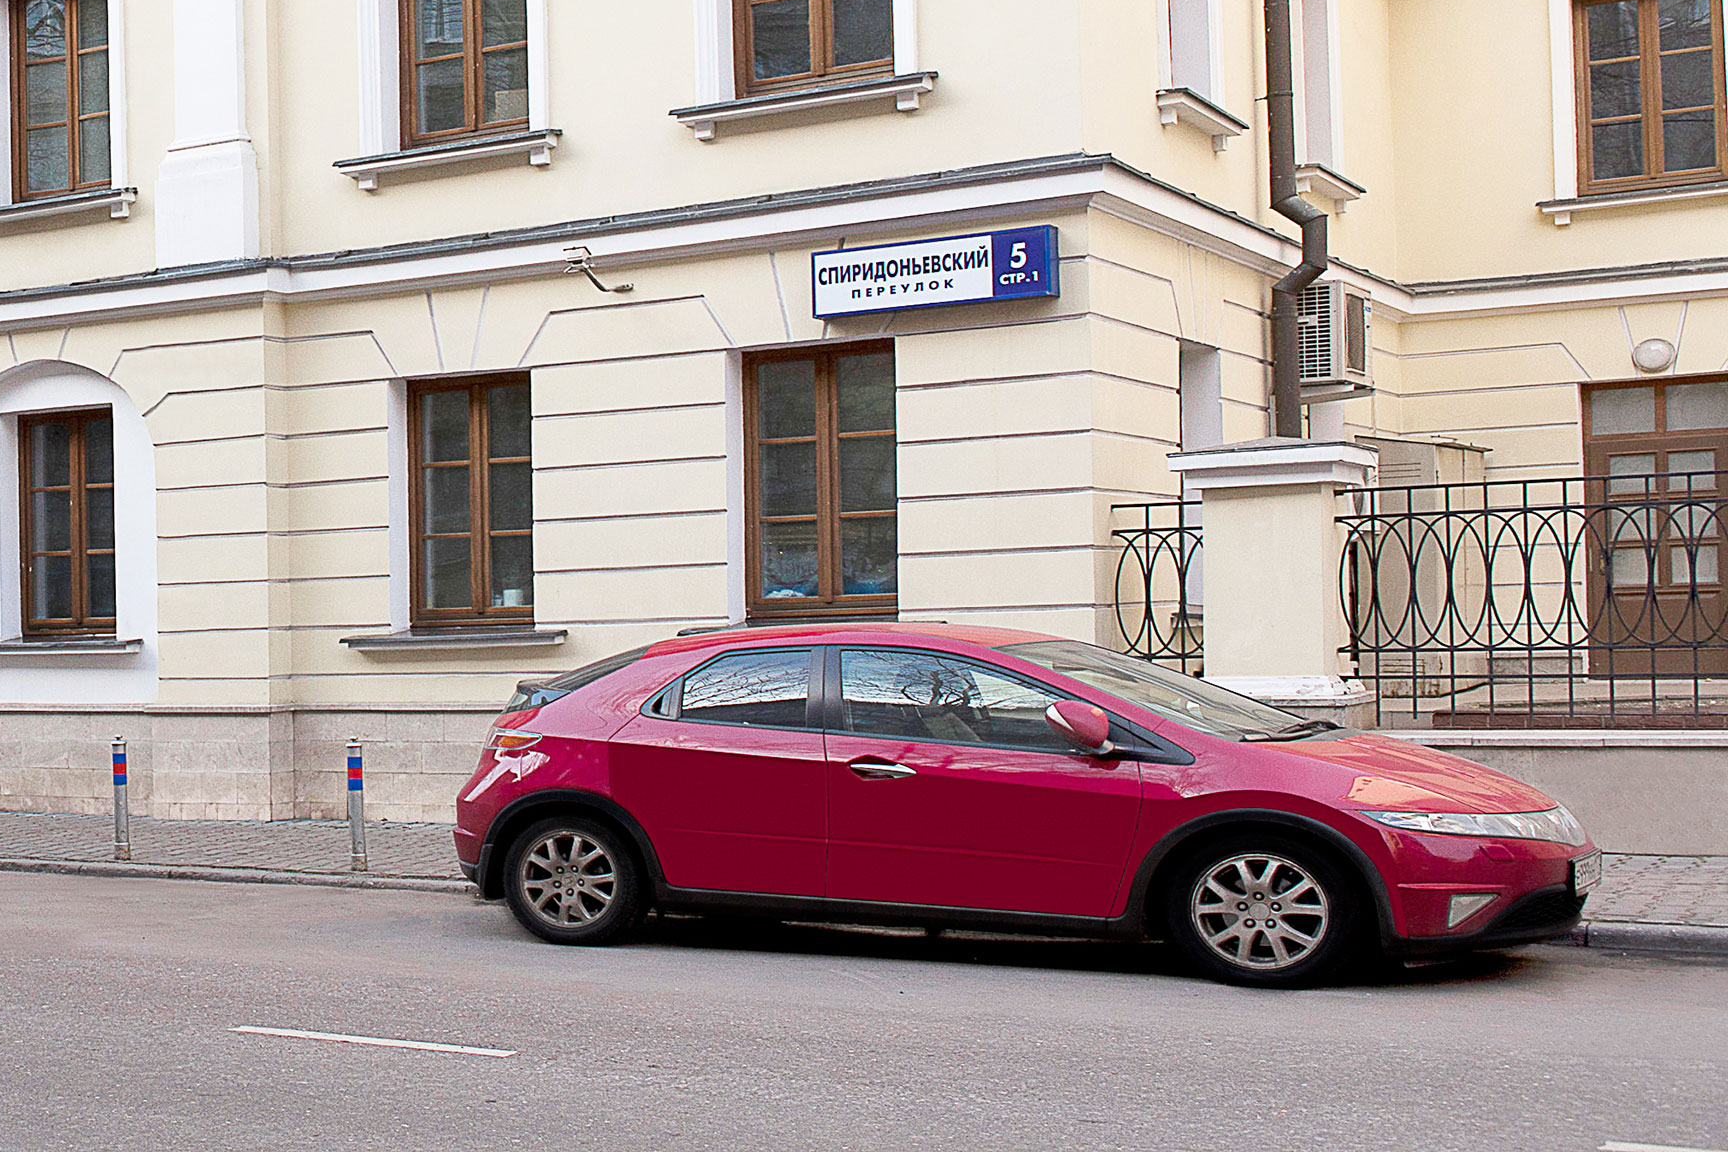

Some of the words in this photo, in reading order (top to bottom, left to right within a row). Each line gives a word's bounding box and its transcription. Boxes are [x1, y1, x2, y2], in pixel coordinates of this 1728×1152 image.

[818, 244, 990, 286] СПИРИДОНЬЕВСКИЙ
[1009, 241, 1028, 269] 5
[851, 278, 955, 299] ПЕРЕУЛОК
